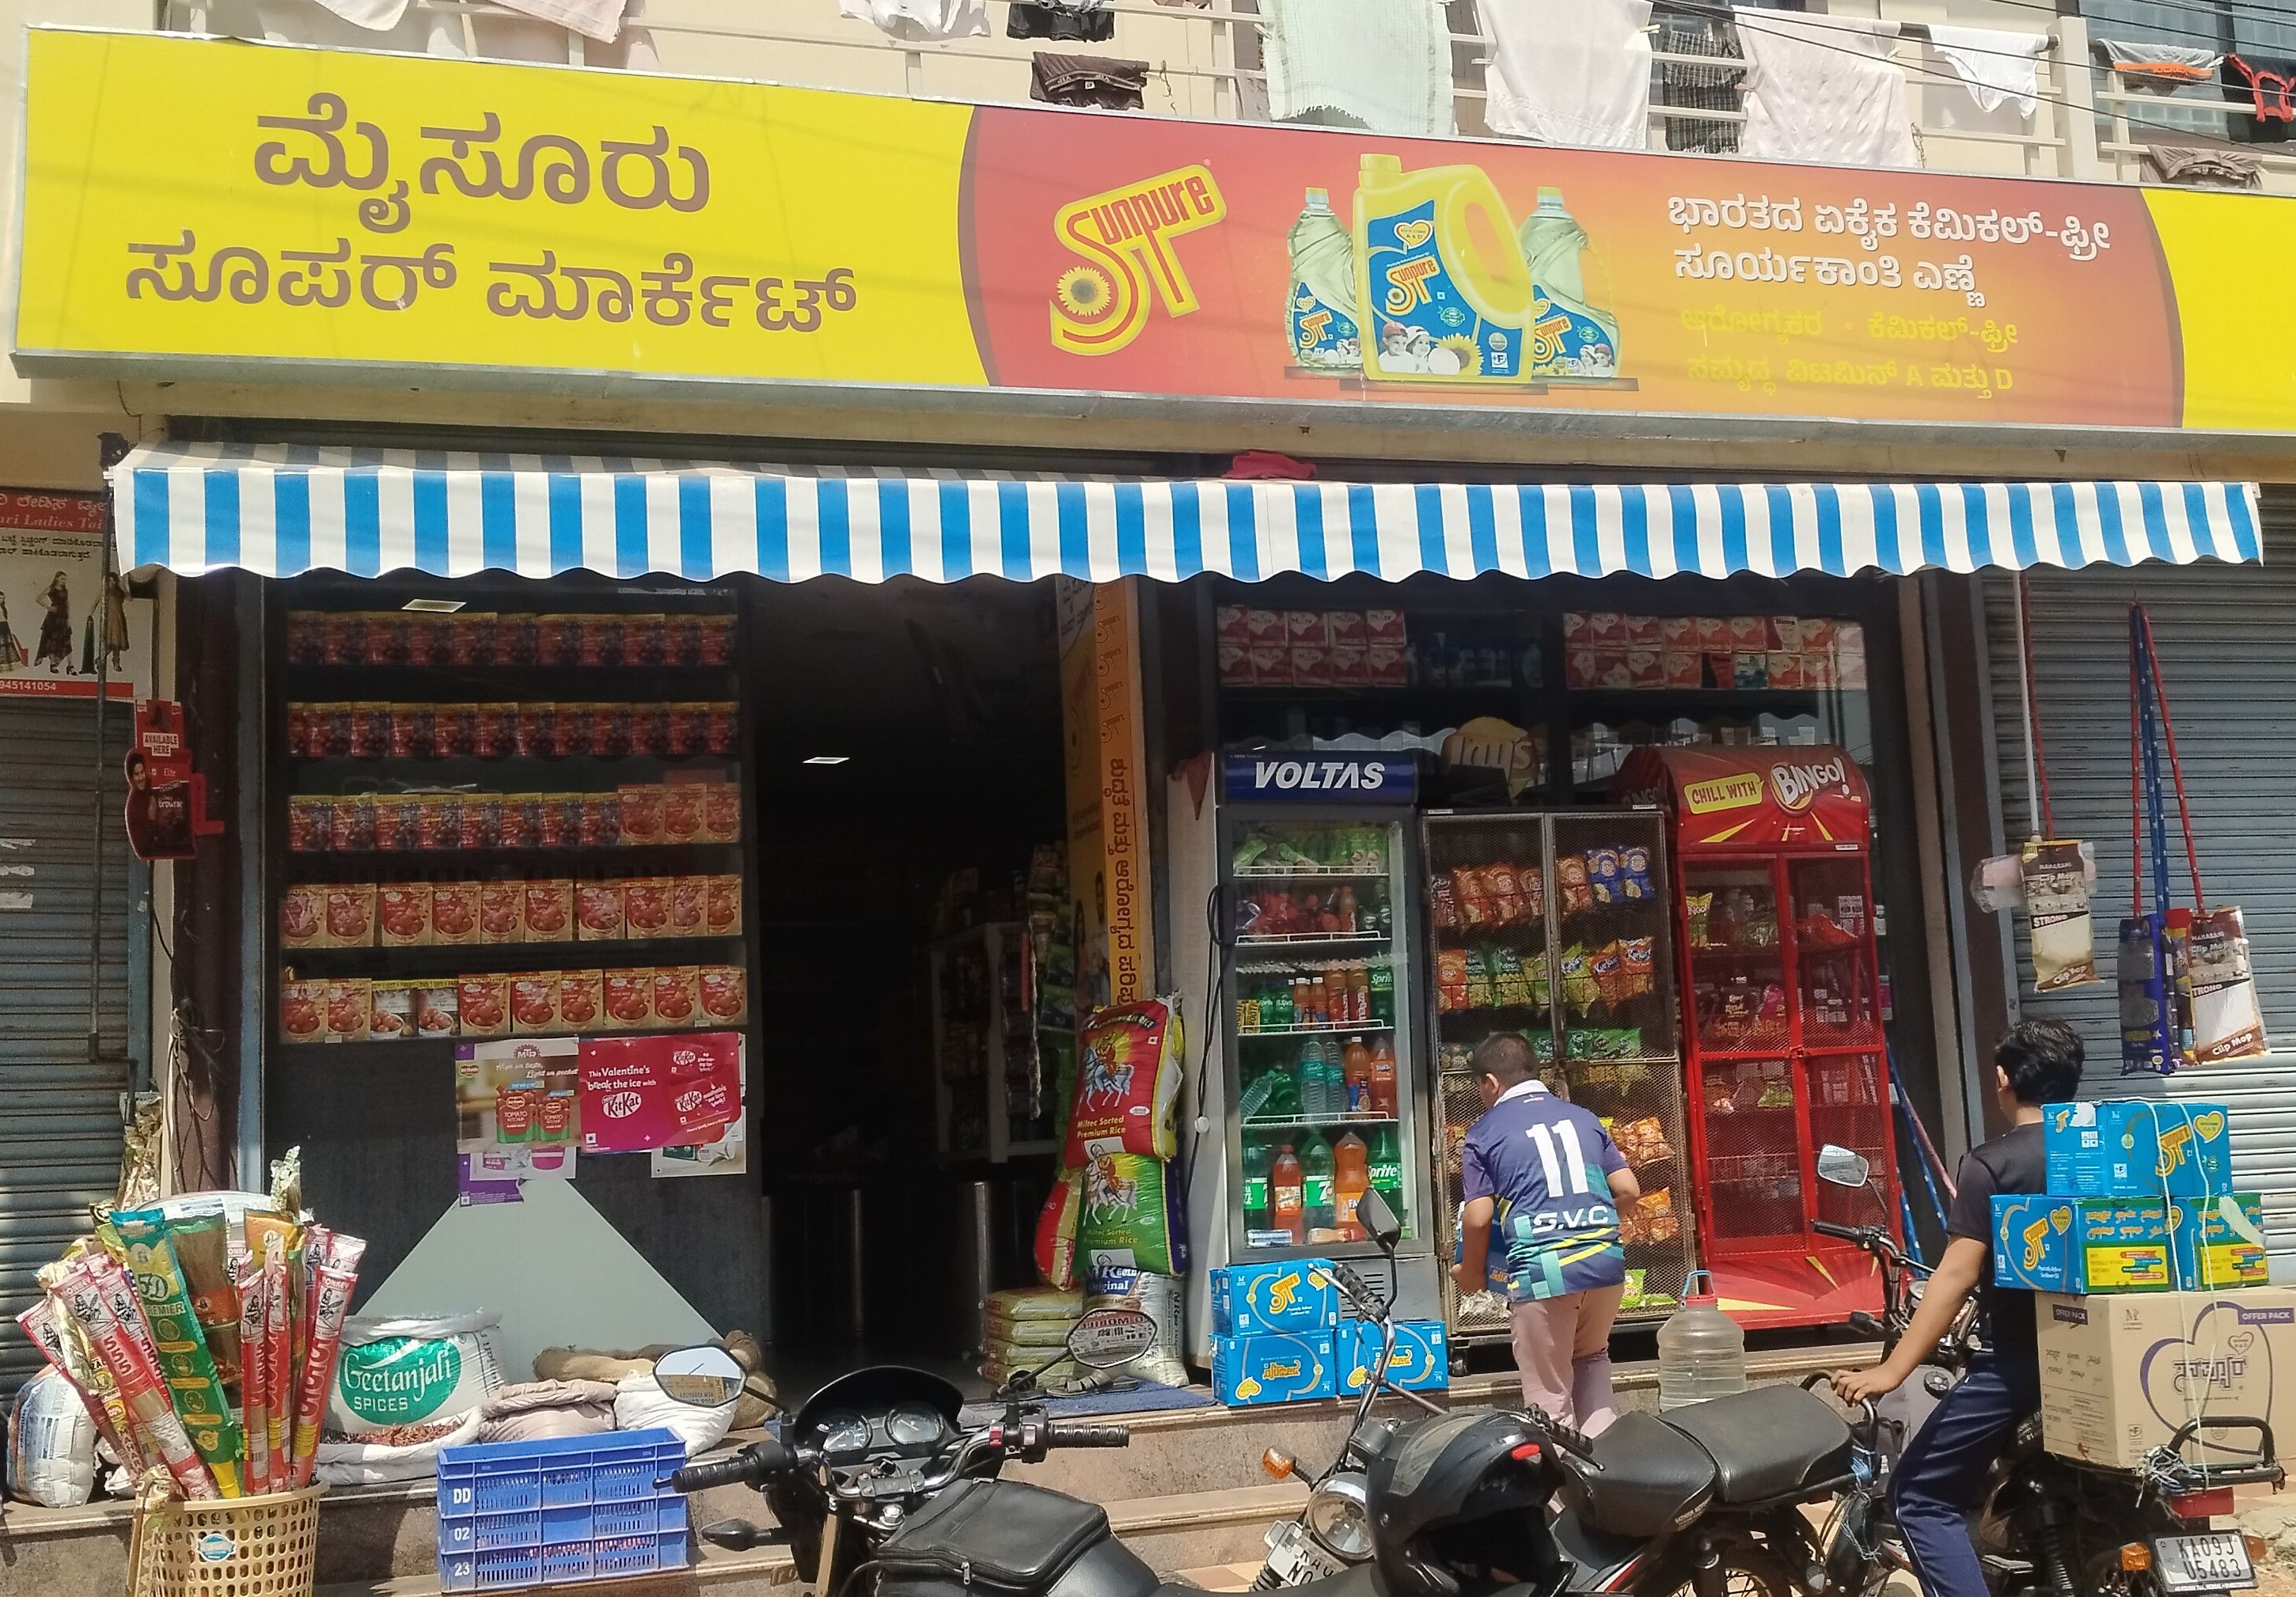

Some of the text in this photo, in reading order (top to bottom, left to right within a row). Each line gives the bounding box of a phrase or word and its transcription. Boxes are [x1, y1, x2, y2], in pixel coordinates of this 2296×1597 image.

[254, 92, 711, 234] ಮೈಸೂರು
[1668, 193, 1803, 233] ಭಾರತದ
[1814, 198, 1898, 252] ಏಕೈಕ
[126, 229, 857, 332] ಸೂಪರ್ ಮಾರ್ಕೆಟ್
[1674, 242, 1986, 308] ಸೂರ್ಯಕಾಂತಿ ಎಣ್ಣೆ
[1906, 366, 1923, 386] A
[1930, 362, 1992, 400] ಮತ್ತು
[1996, 367, 2013, 390] D
[24, 514, 74, 529] Ladies
[144, 734, 178, 745] AVAILABLE
[153, 745, 170, 754] HERE
[1254, 761, 1386, 790] VOLTAS
[1773, 757, 1851, 805] BINGO!
[1691, 781, 1757, 805] CHILL WITH
[1107, 811, 1131, 855] ಮತ್ತು
[2058, 872, 2075, 882] Mop
[2033, 914, 2068, 928] STRONG
[2191, 943, 2229, 954] Clip Mop
[2053, 970, 2070, 985] Clip
[2212, 1033, 2253, 1056] Clip Mop
[518, 1049, 537, 1058] MTR
[601, 1064, 651, 1077] Valentine's
[586, 1079, 612, 1091] break
[613, 1079, 628, 1089] the
[629, 1079, 641, 1087] ice
[608, 1093, 639, 1117] KitKat
[678, 1091, 702, 1111] KitKat
[1099, 1114, 1125, 1125] Sorted
[1077, 1126, 1126, 1139] Premium Rice
[1525, 1118, 1589, 1198] 11
[1106, 1227, 1131, 1236] Sorted
[139, 1272, 169, 1302] 5D
[1088, 1280, 1129, 1293] Original
[2071, 1311, 2085, 1320] PACK
[103, 1335, 132, 1375] 555
[344, 1349, 452, 1402] Geetanjali
[354, 1396, 408, 1412] SPICES
[454, 1488, 471, 1504] DD
[454, 1527, 470, 1542] 02
[454, 1561, 470, 1576] 23
[2183, 1558, 2241, 1580] U5483
